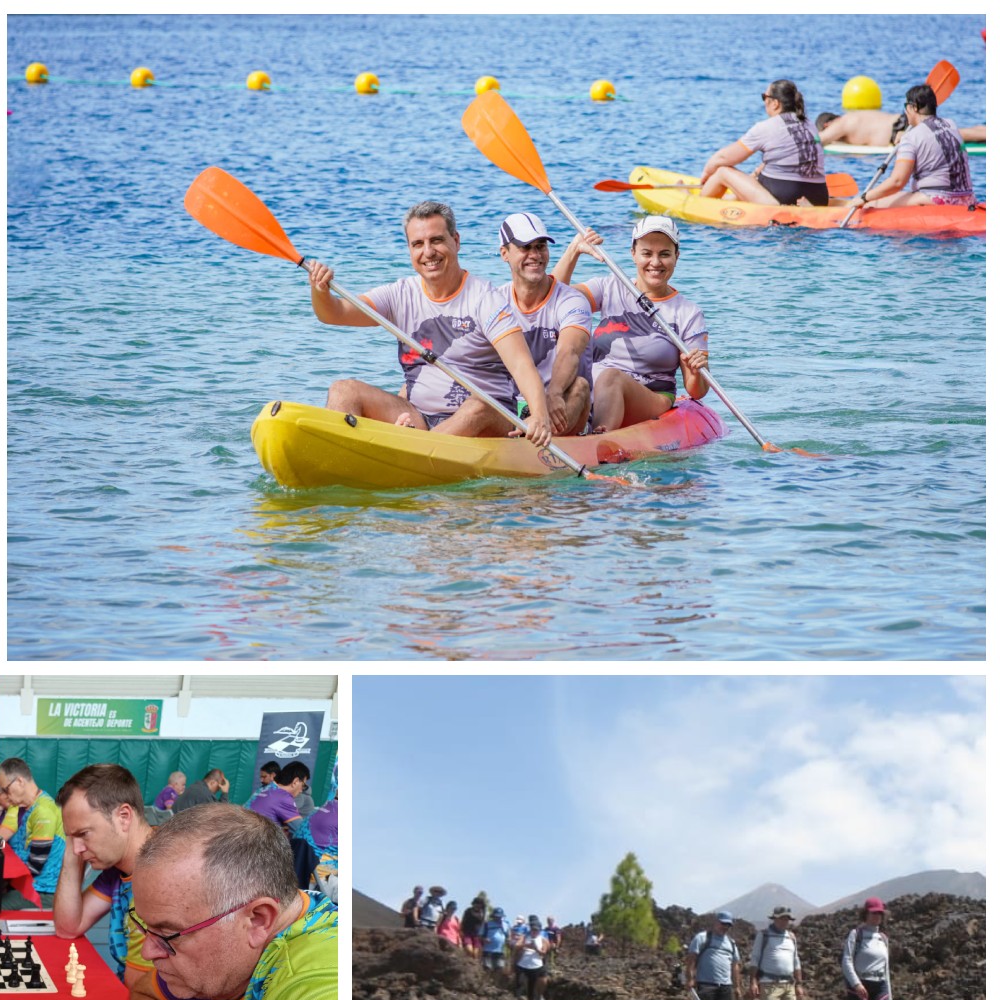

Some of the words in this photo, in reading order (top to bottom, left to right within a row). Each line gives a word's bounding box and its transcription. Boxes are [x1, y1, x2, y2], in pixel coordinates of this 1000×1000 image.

[48, 702, 62, 717] LA
[63, 703, 107, 717] VICTORIA
[108, 709, 117, 719] ES
[63, 718, 72, 727] DE
[73, 718, 105, 728] ACENTEJO
[106, 719, 133, 728] DEPORTE
